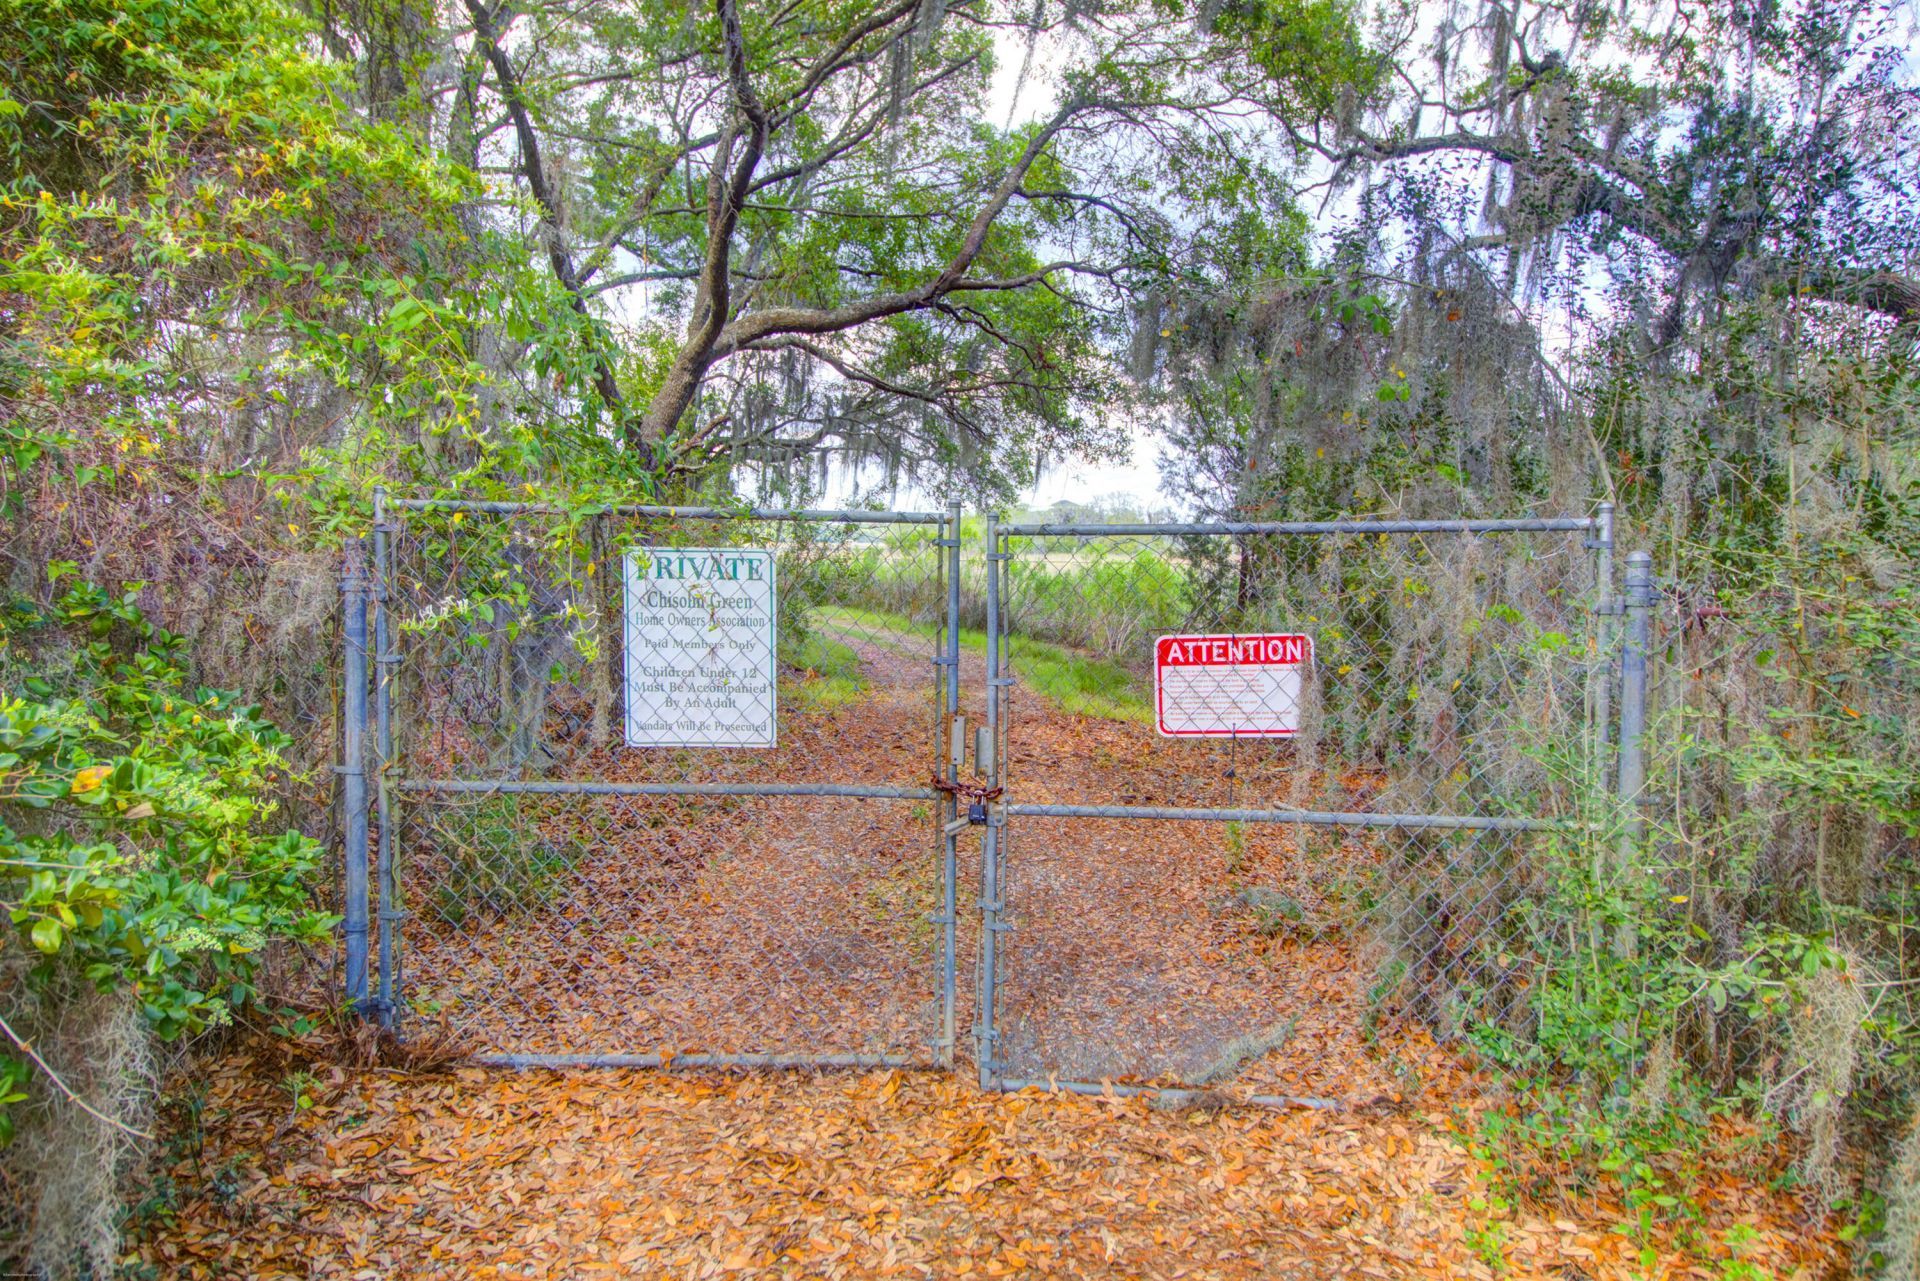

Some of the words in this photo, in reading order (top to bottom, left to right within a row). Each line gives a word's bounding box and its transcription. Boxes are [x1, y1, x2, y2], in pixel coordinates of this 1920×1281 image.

[709, 592, 752, 610] Green
[635, 612, 664, 626] Home
[667, 612, 705, 627] Owners
[644, 639, 668, 649] Paid
[673, 639, 725, 650] Members
[728, 640, 757, 651] Only
[1167, 639, 1303, 663] ATTENTION
[643, 666, 695, 678] Children
[700, 667, 738, 679] Under
[743, 667, 757, 679] 12
[633, 682, 665, 693] Must
[669, 682, 684, 692] Be
[688, 682, 767, 696] Accompanied
[665, 698, 680, 710] By
[684, 698, 701, 708] An
[704, 698, 737, 708] Adult
[636, 720, 673, 731] Vandals
[676, 721, 696, 731] Will
[698, 721, 711, 731] Be
[714, 721, 767, 732] Prosecuted
